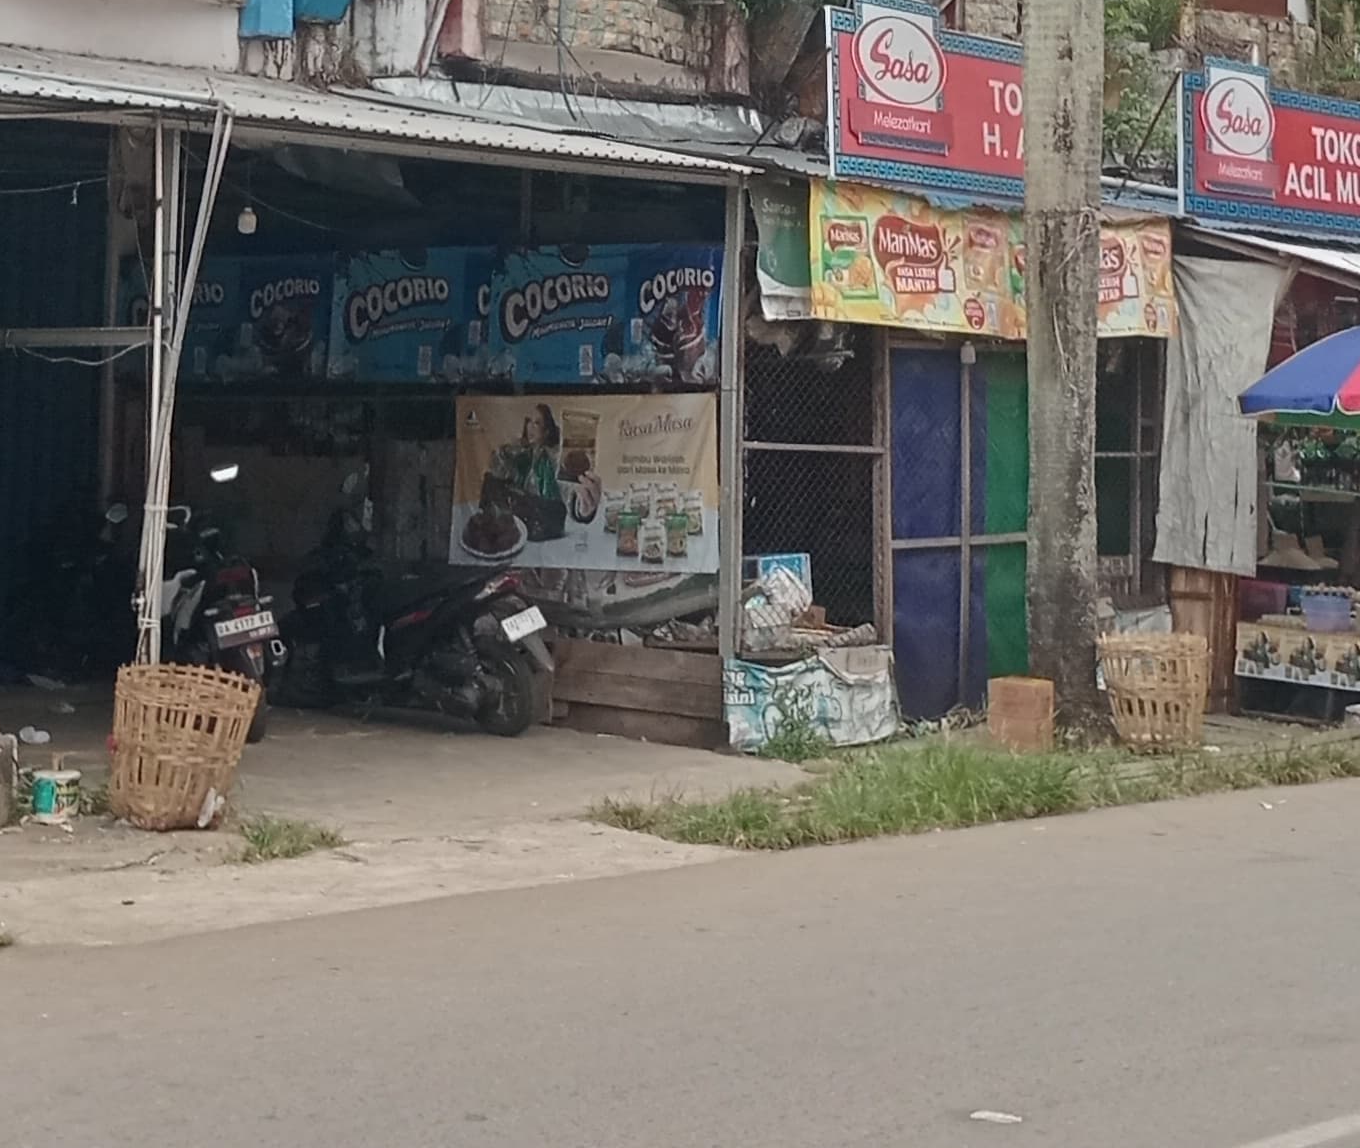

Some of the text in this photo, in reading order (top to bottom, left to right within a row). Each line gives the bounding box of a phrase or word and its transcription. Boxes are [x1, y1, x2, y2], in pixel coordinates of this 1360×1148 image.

[869, 27, 933, 84] Sasa
[988, 78, 1024, 117] TO
[1215, 87, 1264, 136] Sasa
[1284, 162, 1332, 202] ACIL
[878, 225, 939, 260] ManMas
[250, 277, 321, 319] COCORIO
[348, 277, 449, 339] COCORIO
[503, 273, 610, 339] COCORIO
[640, 266, 716, 314] COCORIO
